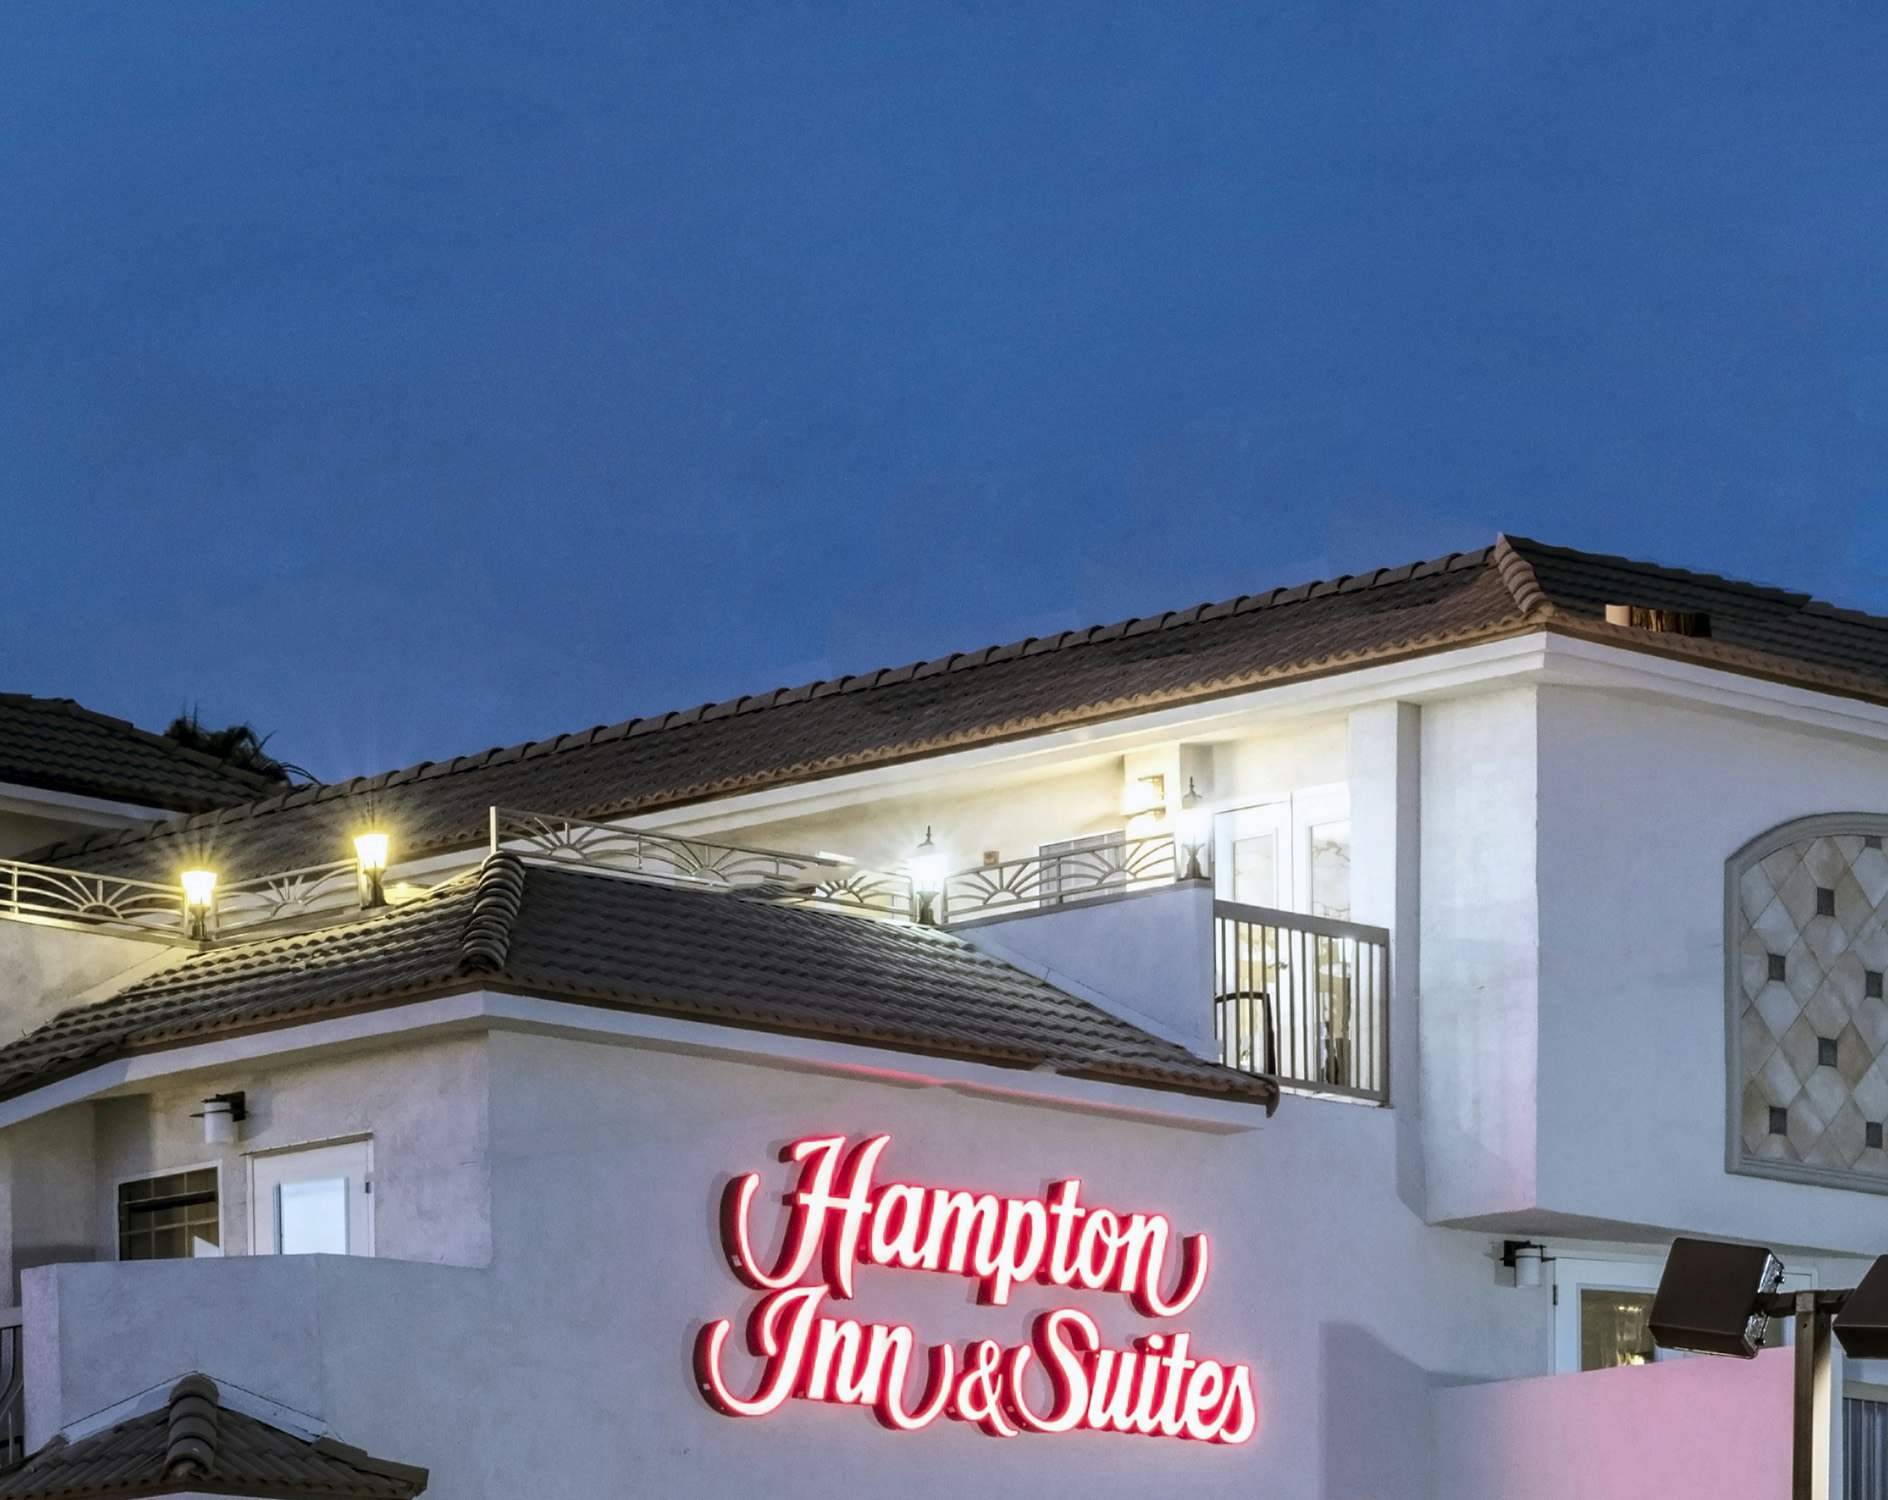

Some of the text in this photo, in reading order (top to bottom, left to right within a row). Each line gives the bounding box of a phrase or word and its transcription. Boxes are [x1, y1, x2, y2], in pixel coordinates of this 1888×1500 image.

[724, 1133, 1209, 1318] Hampton
[702, 1286, 1257, 1445] Inn & Suites
